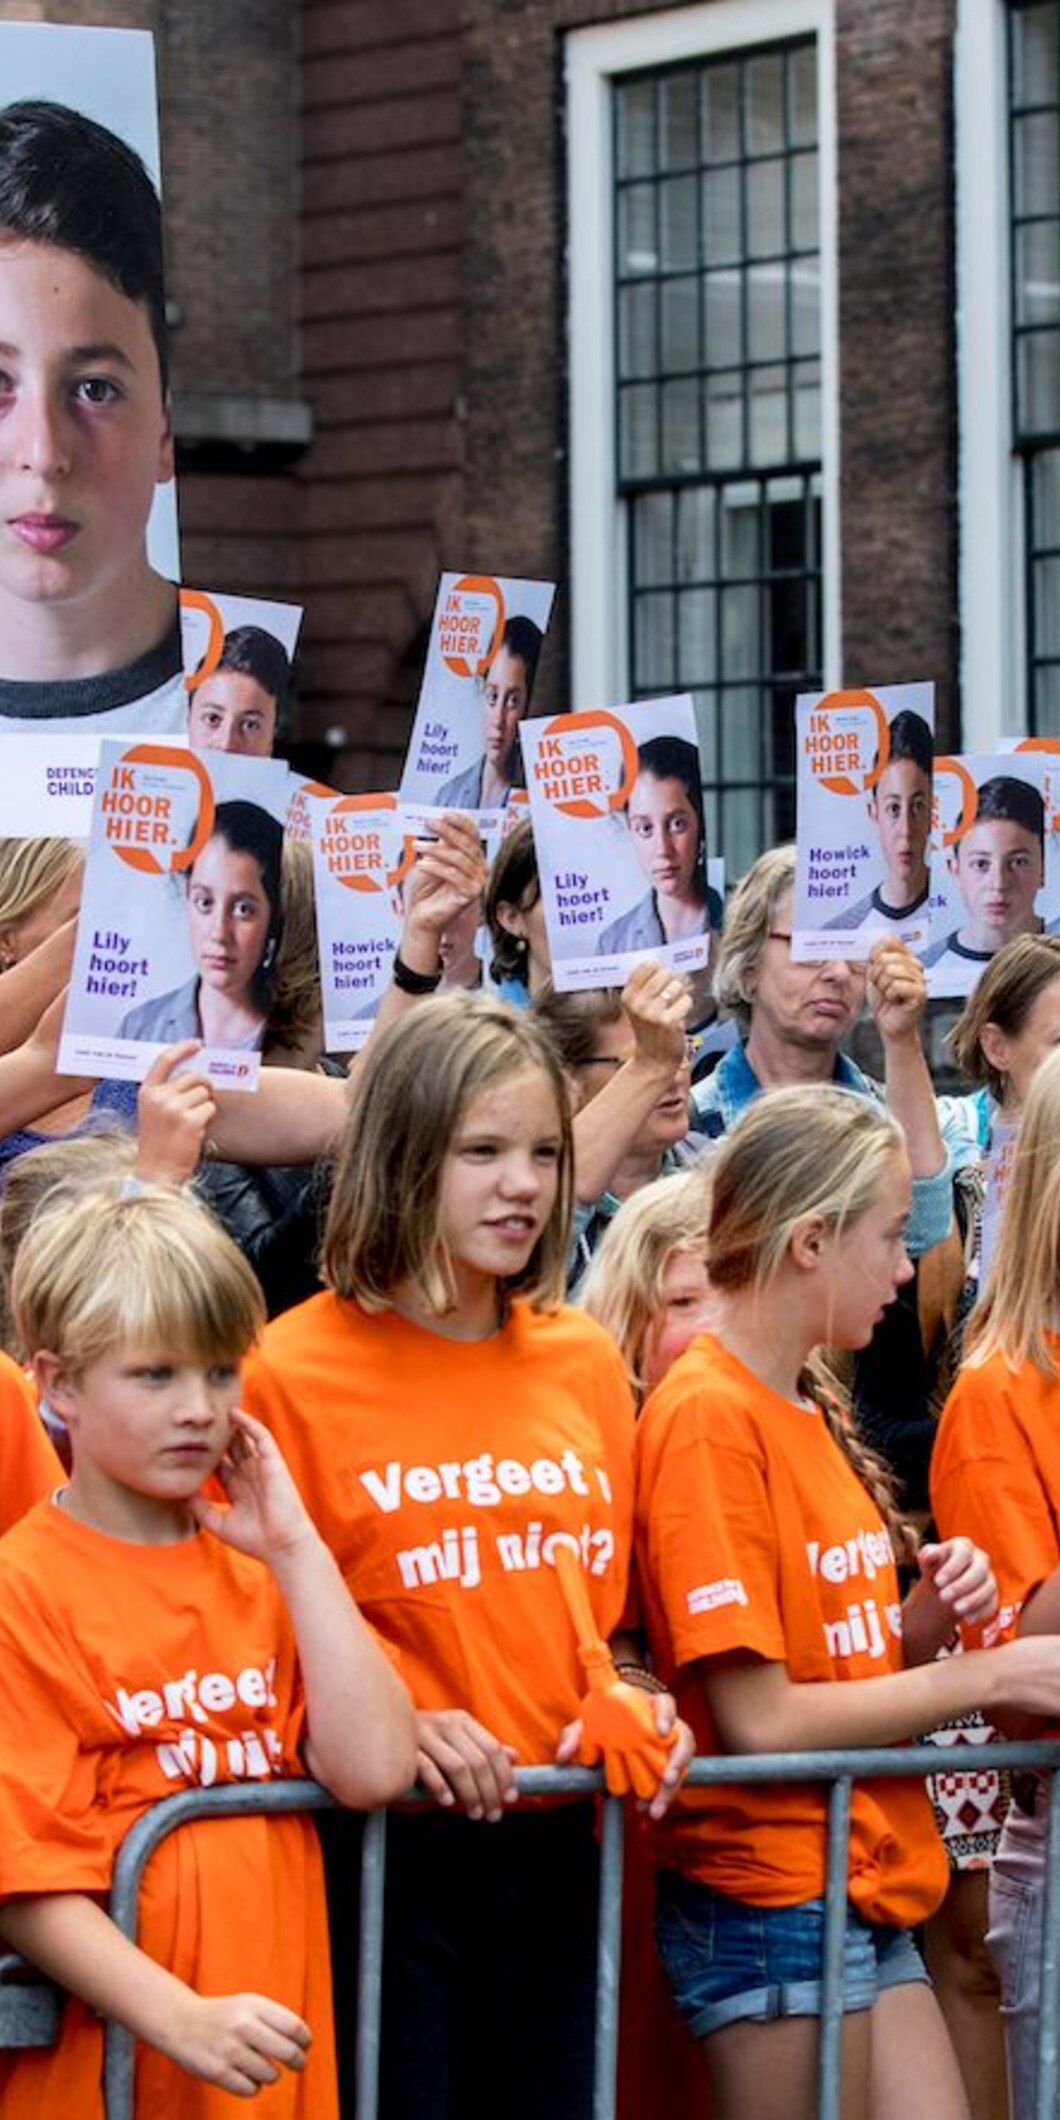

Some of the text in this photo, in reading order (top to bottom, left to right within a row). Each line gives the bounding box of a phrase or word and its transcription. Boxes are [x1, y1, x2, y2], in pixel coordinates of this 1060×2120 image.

[445, 595, 462, 612] IK
[439, 614, 481, 634] HOOR
[440, 634, 482, 654] HIER.
[424, 723, 449, 741] Lily
[809, 714, 831, 732] IK
[420, 742, 458, 758] hoort
[537, 739, 563, 758] IK
[804, 732, 859, 753] HOOR
[416, 757, 451, 774] hier!
[534, 754, 599, 779] HOOR
[811, 754, 867, 774] HIER.
[112, 767, 136, 790] IK
[543, 775, 611, 800] HIER.
[101, 792, 171, 818] HOOR
[105, 817, 178, 845] HIER.
[325, 818, 347, 834] IK
[320, 834, 381, 854] HOOR
[809, 845, 871, 863] Howick
[328, 853, 390, 873] HIER.
[808, 864, 857, 880] hoort
[555, 872, 589, 891] Lily
[807, 882, 850, 898] hier!
[557, 887, 610, 908] hoort
[559, 905, 604, 926] hier!
[93, 931, 131, 955] Lily
[332, 938, 396, 955] Howick
[89, 954, 149, 976] hoort
[333, 957, 382, 973] hoort
[86, 976, 138, 997] hier!
[334, 974, 376, 990] hier!
[359, 1449, 589, 1513] Vergeet
[396, 1526, 482, 1589] mij
